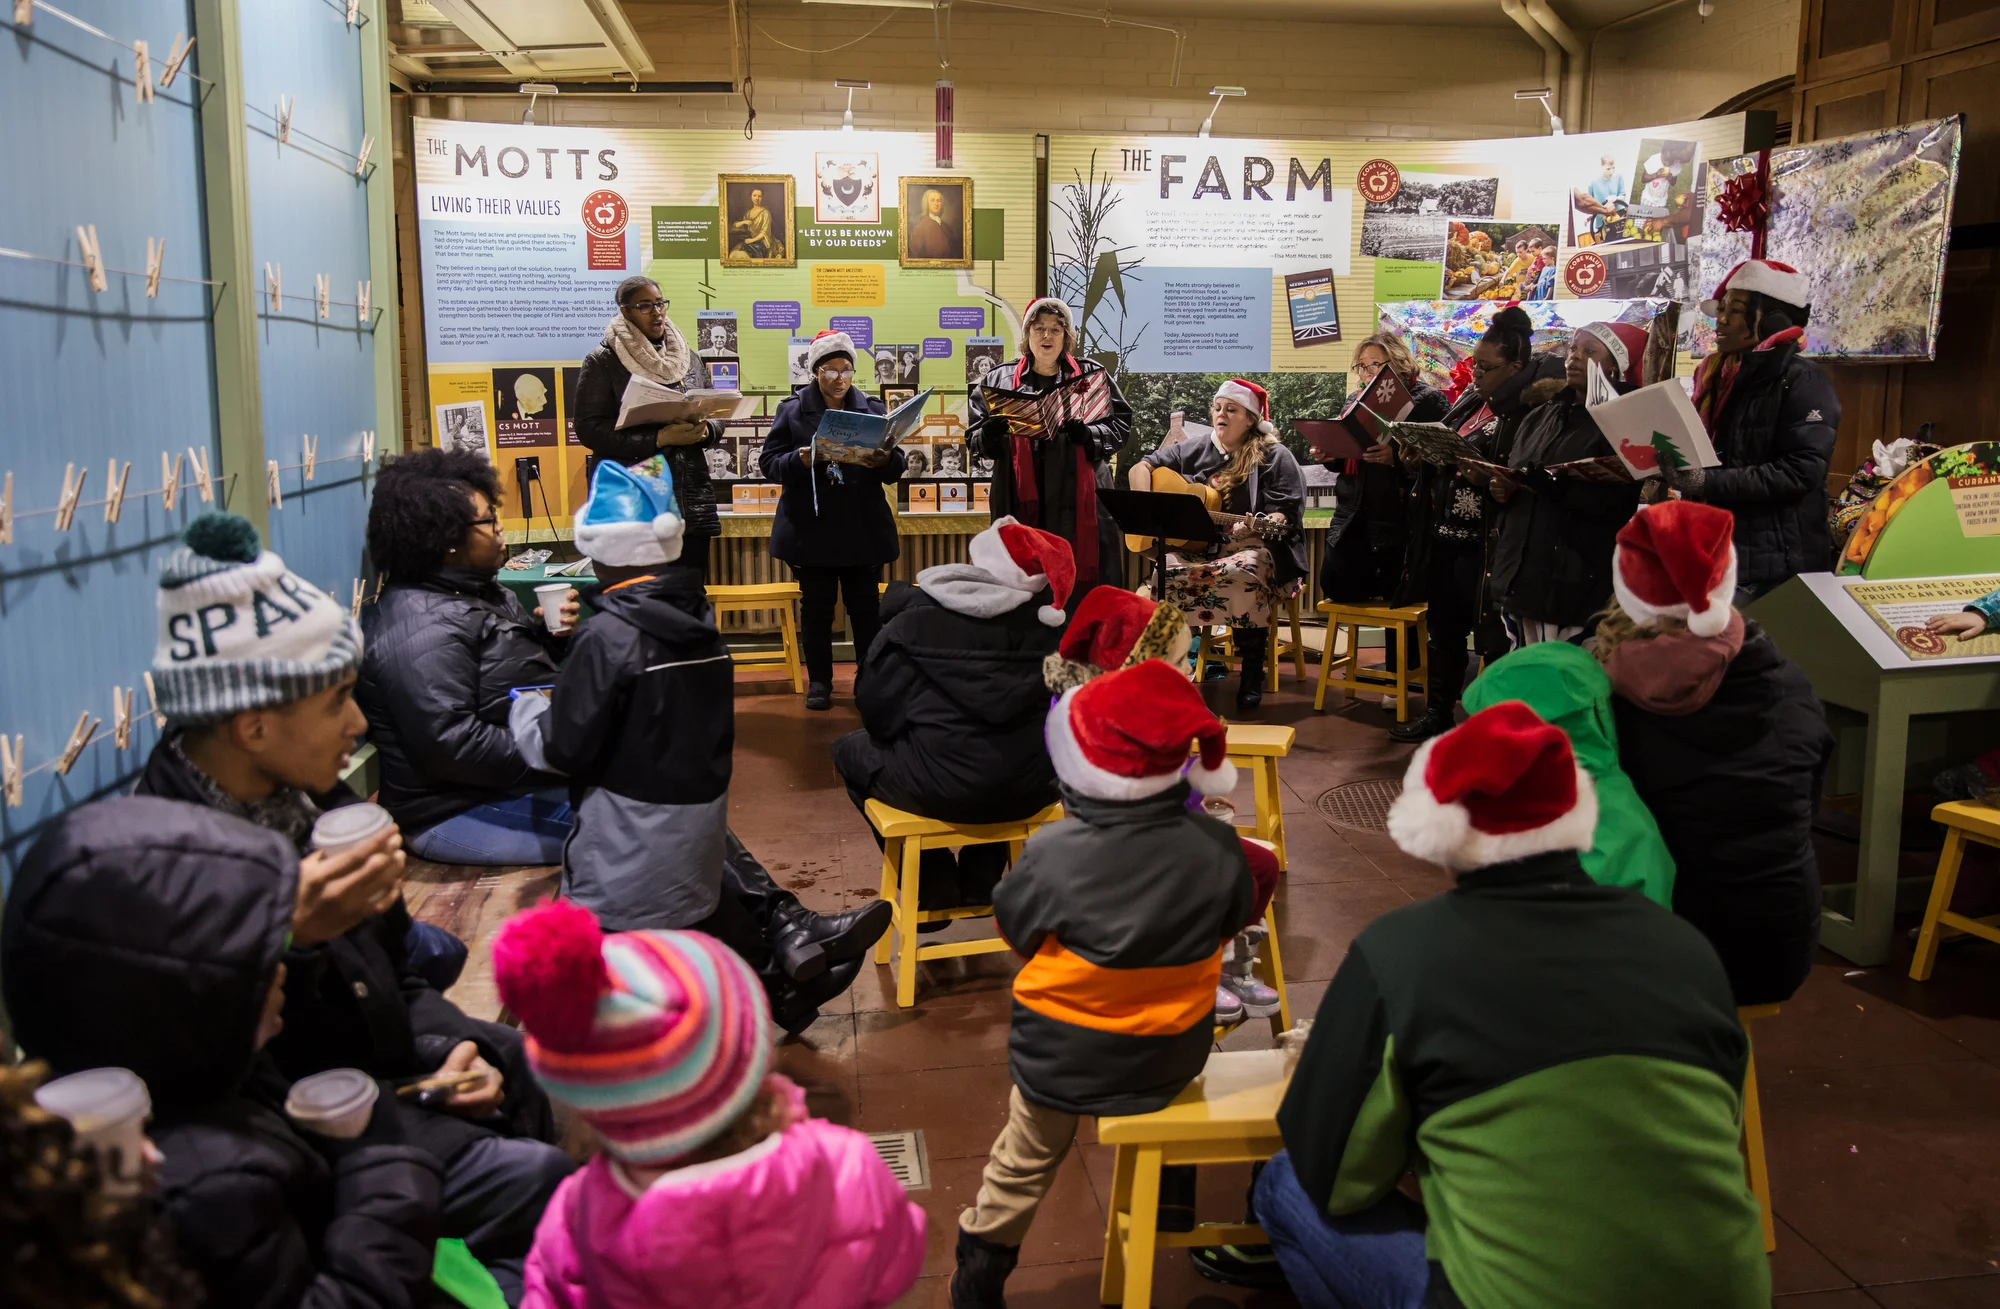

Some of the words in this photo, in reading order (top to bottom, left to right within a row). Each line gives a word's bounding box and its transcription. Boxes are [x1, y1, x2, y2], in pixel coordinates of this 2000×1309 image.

[427, 138, 448, 156] THE
[455, 143, 619, 181] MOTTS
[1121, 149, 1152, 171] THE
[1362, 163, 1376, 176] CORE
[1378, 163, 1395, 176] VALUE
[1160, 154, 1333, 202] FARM
[432, 196, 471, 213] LIVING
[476, 198, 511, 214] THEIR
[516, 199, 560, 216] VALUES
[446, 237, 464, 245] deeply
[511, 238, 530, 246] guided
[518, 231, 546, 239] principled
[1569, 255, 1584, 270] CORE
[1585, 255, 1602, 268] VALUE
[1601, 328, 1611, 340] OR
[1609, 338, 1625, 356] NICE?
[1854, 584, 1913, 593] CHERRIES
[168, 574, 322, 662] SPAR
